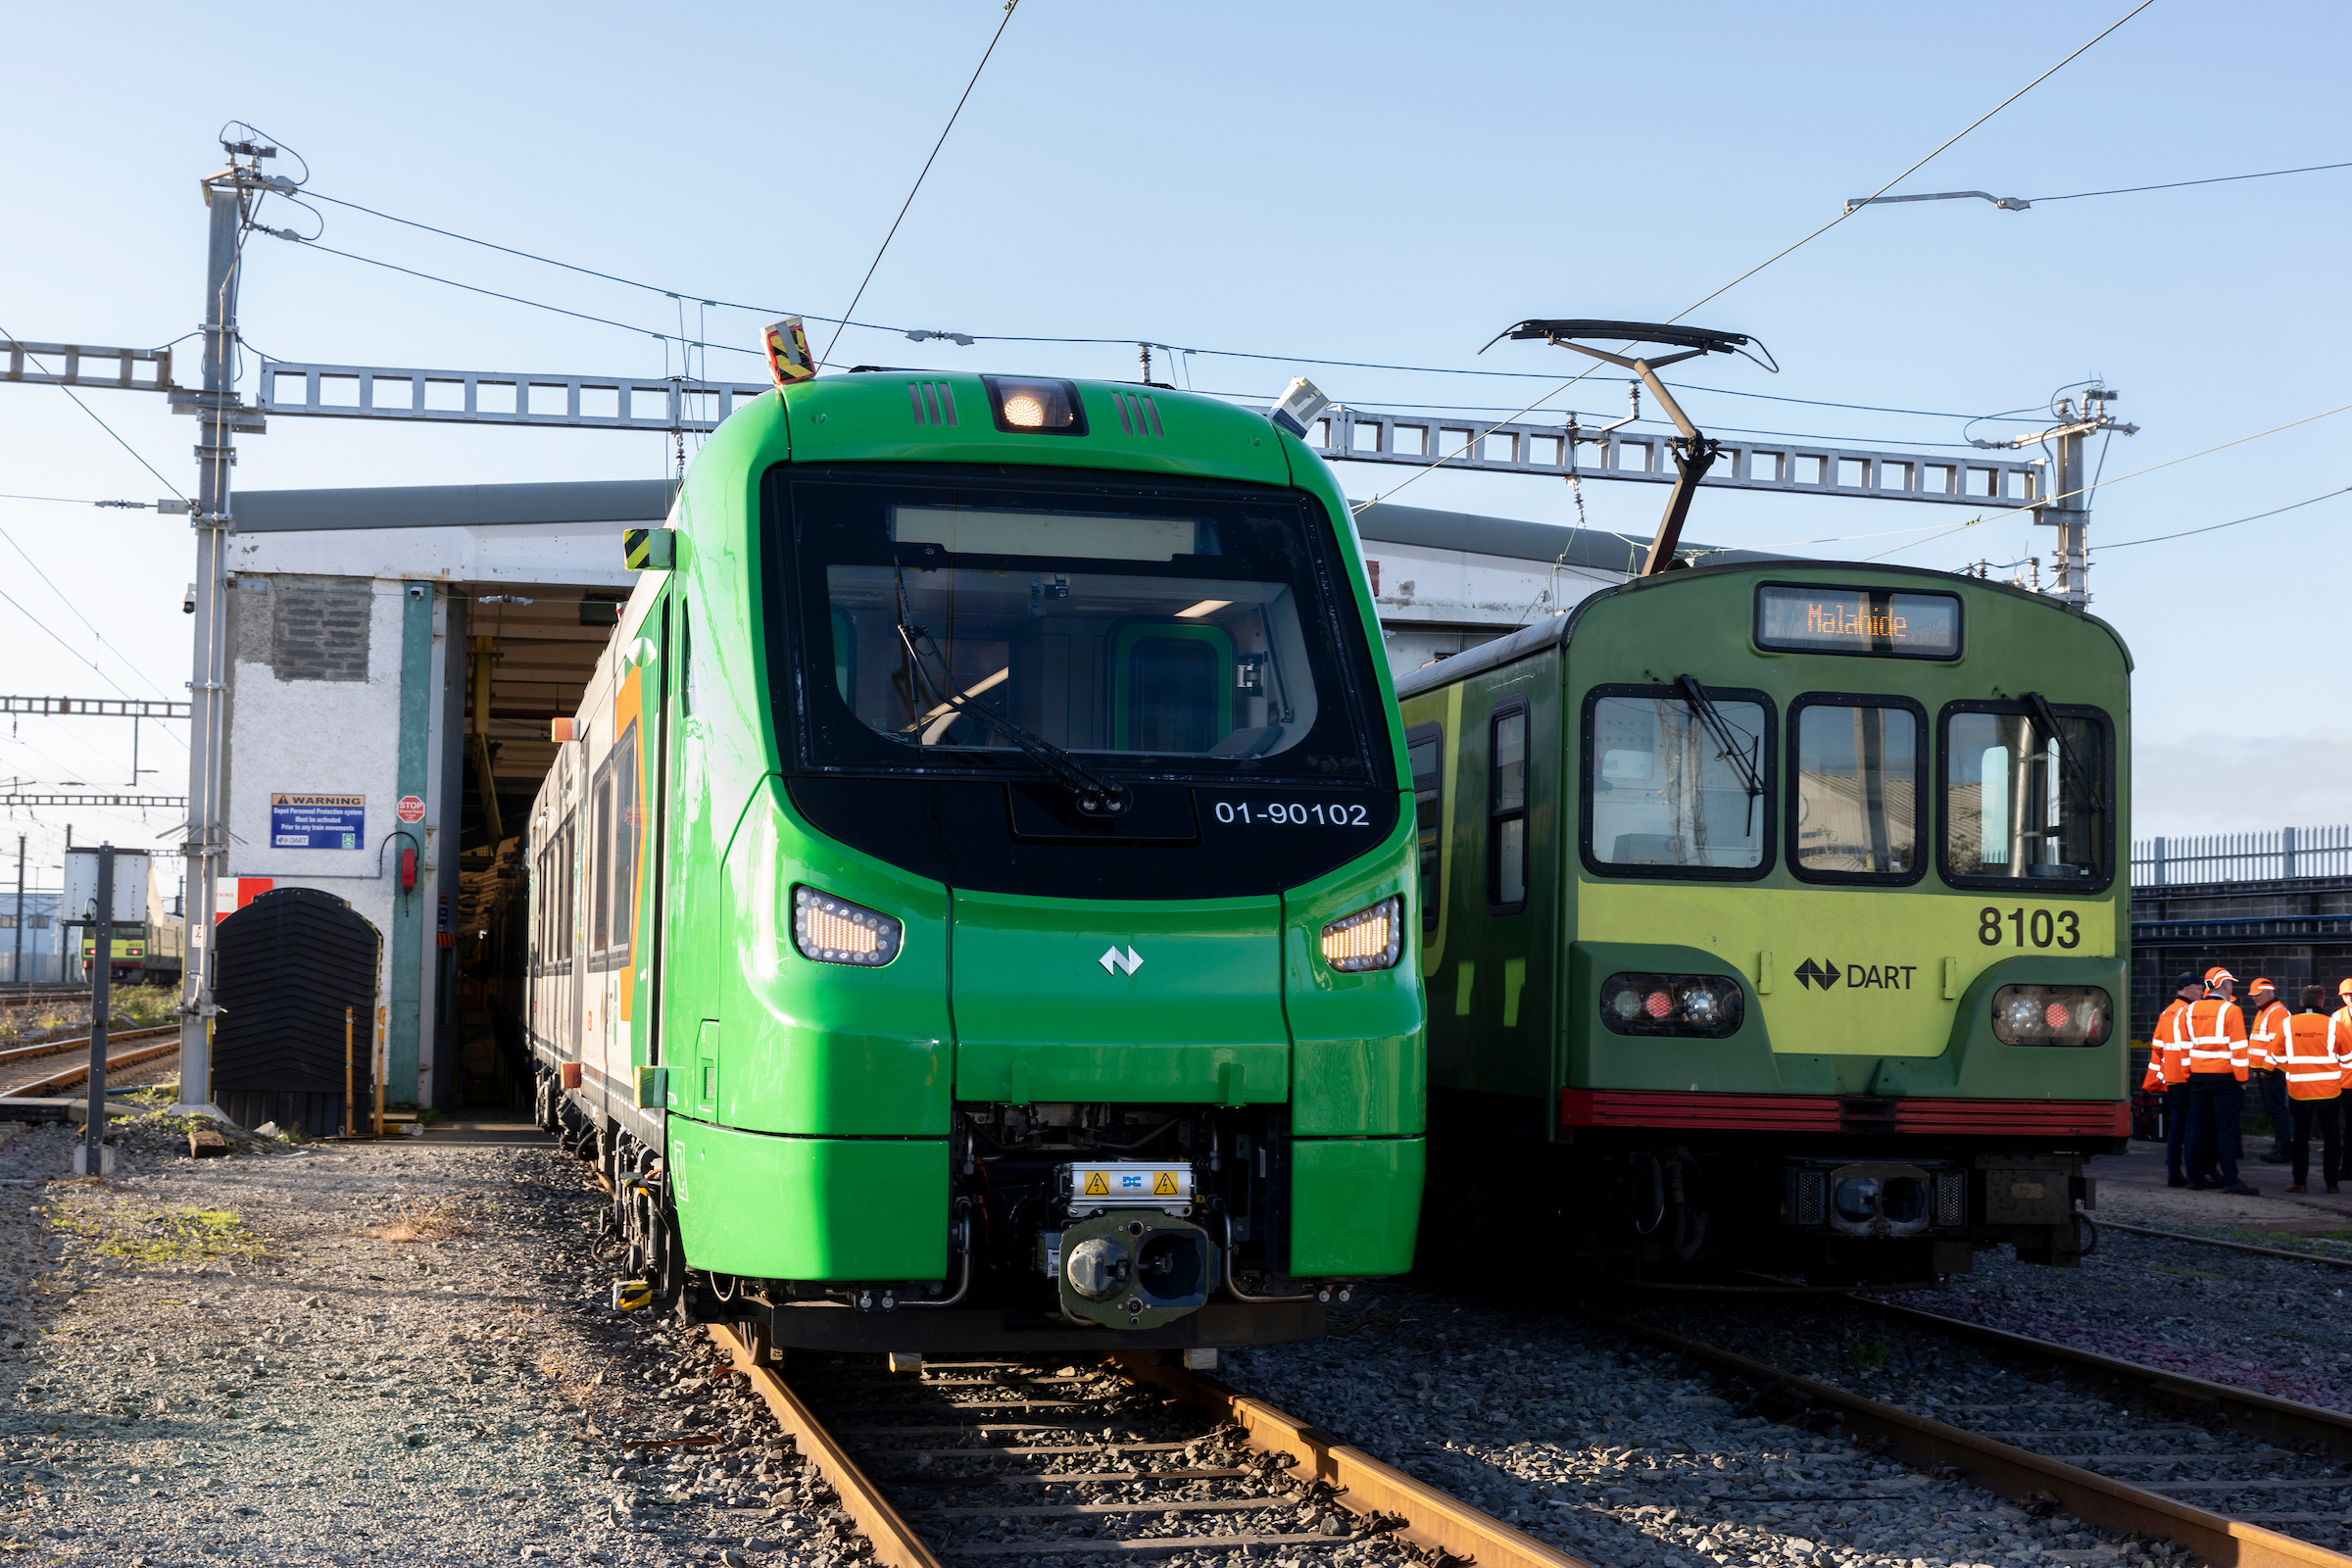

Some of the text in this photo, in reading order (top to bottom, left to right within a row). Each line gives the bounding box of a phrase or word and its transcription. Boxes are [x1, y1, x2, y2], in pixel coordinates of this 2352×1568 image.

[1807, 603, 1907, 637] Malahide
[273, 807, 289, 815] Depot
[292, 797, 362, 806] WARNING
[1214, 802, 1370, 826] 01-90102
[1978, 906, 2081, 949] 8103
[1846, 964, 1917, 990] DART
